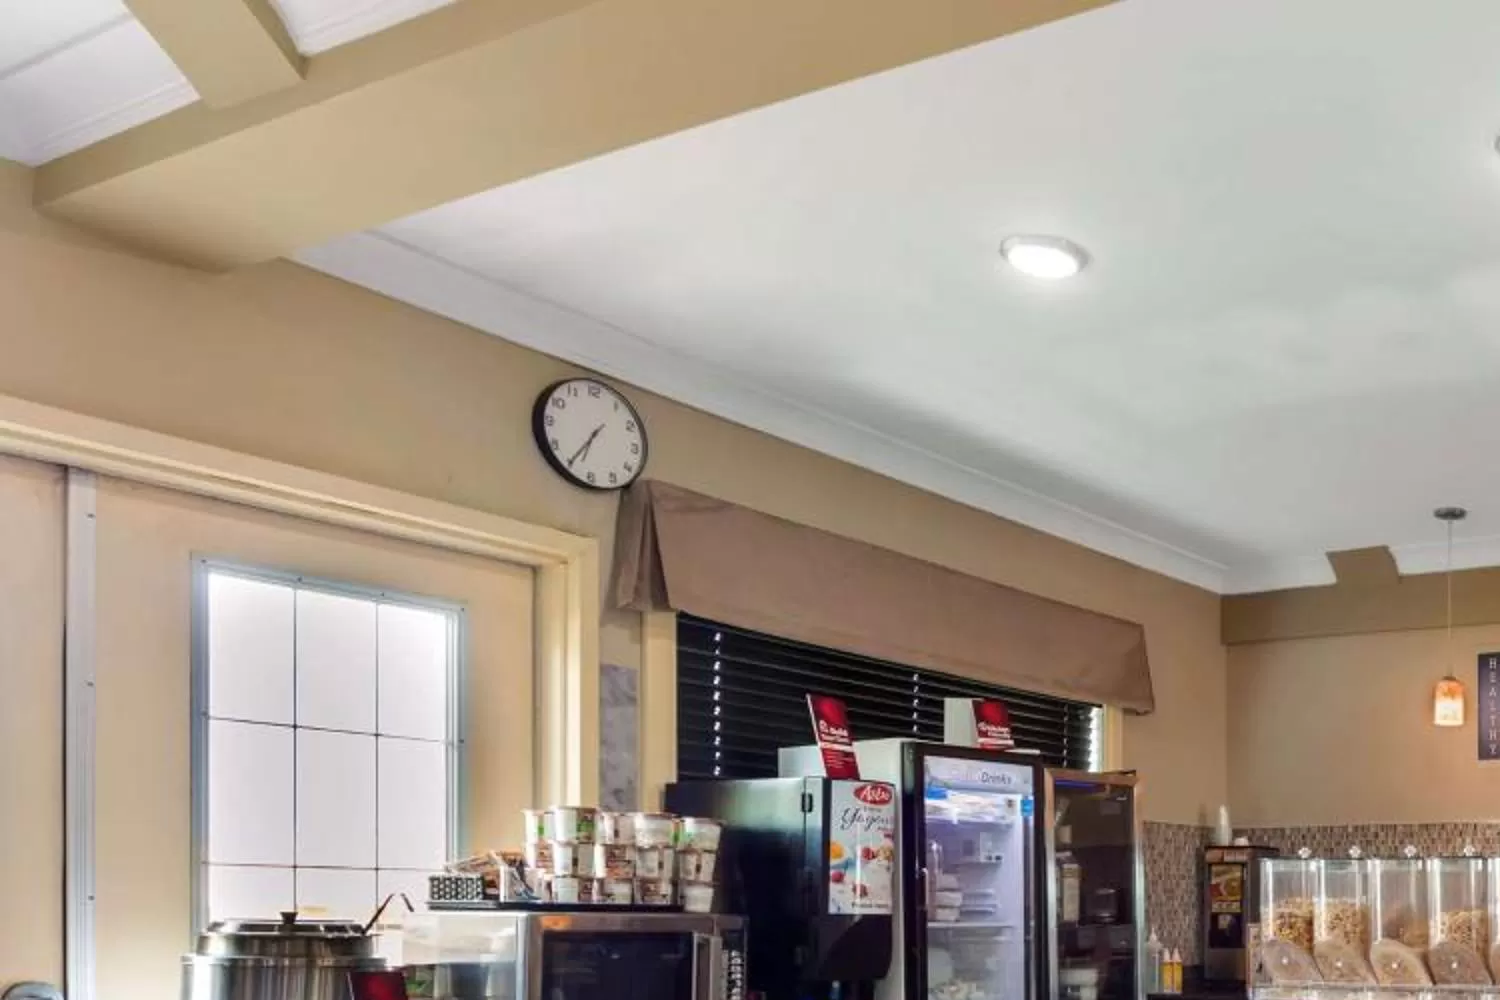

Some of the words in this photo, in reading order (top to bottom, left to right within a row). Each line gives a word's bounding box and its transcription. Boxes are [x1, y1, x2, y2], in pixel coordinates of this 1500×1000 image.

[588, 385, 601, 399] 12
[552, 397, 566, 410] 10
[1488, 657, 1497, 756] HEALTHY
